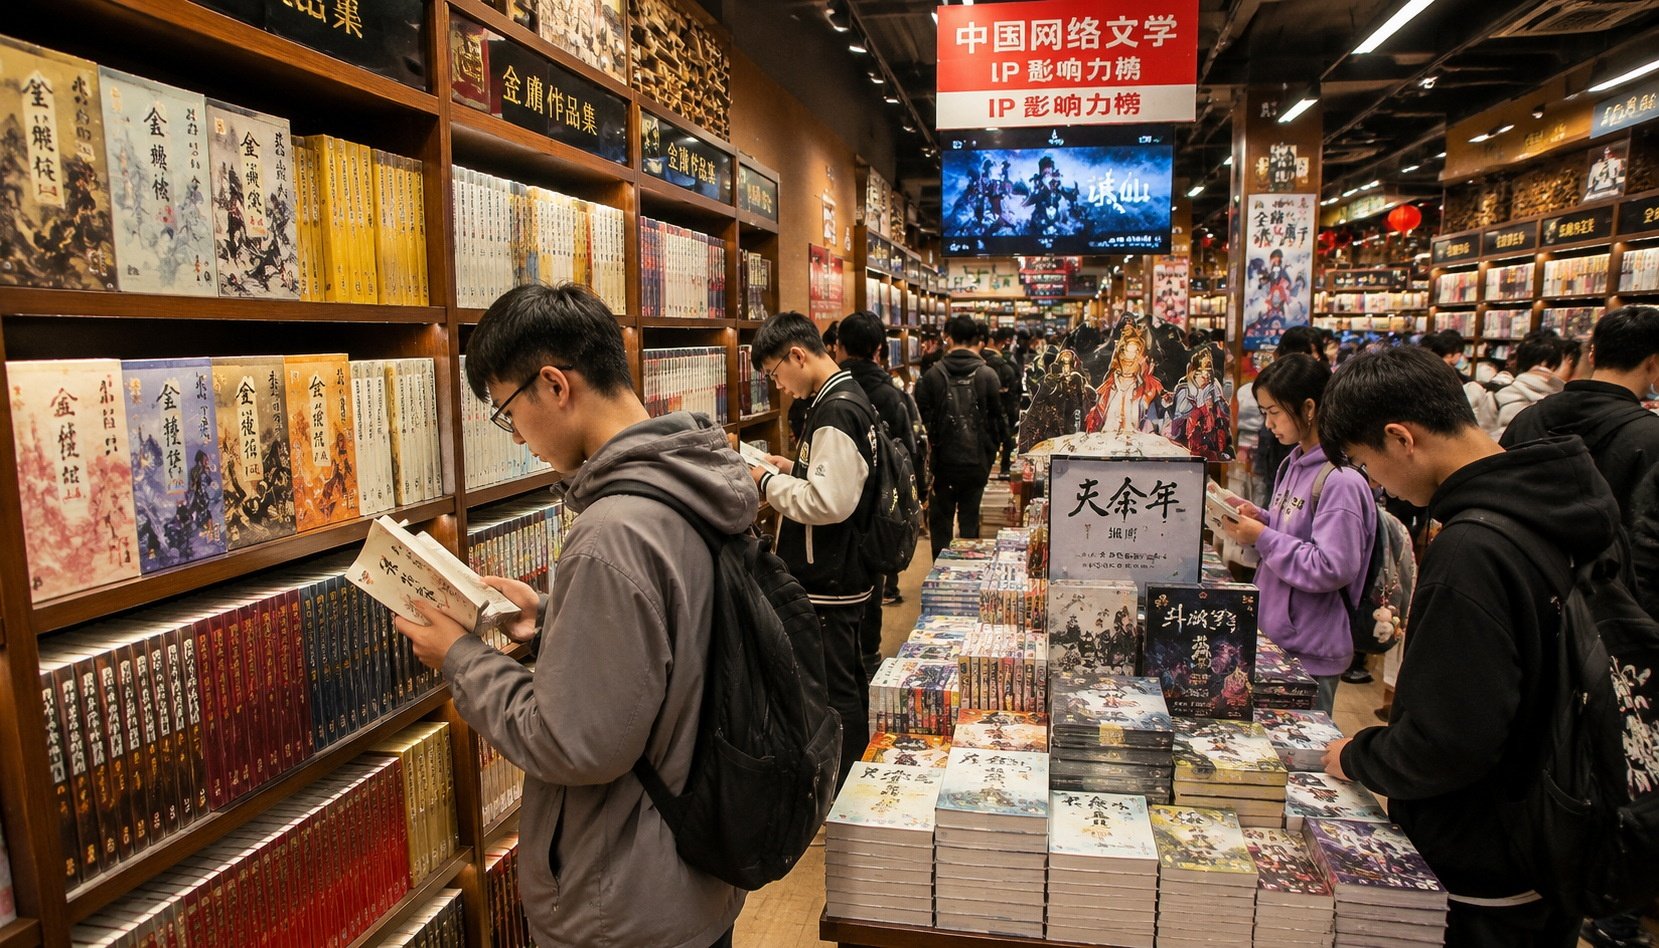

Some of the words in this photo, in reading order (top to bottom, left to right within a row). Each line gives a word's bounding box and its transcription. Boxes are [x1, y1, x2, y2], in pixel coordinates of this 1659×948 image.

[956, 14, 1177, 54] 中国网络文学
[991, 61, 1020, 83] IP
[988, 98, 1016, 118] IP
